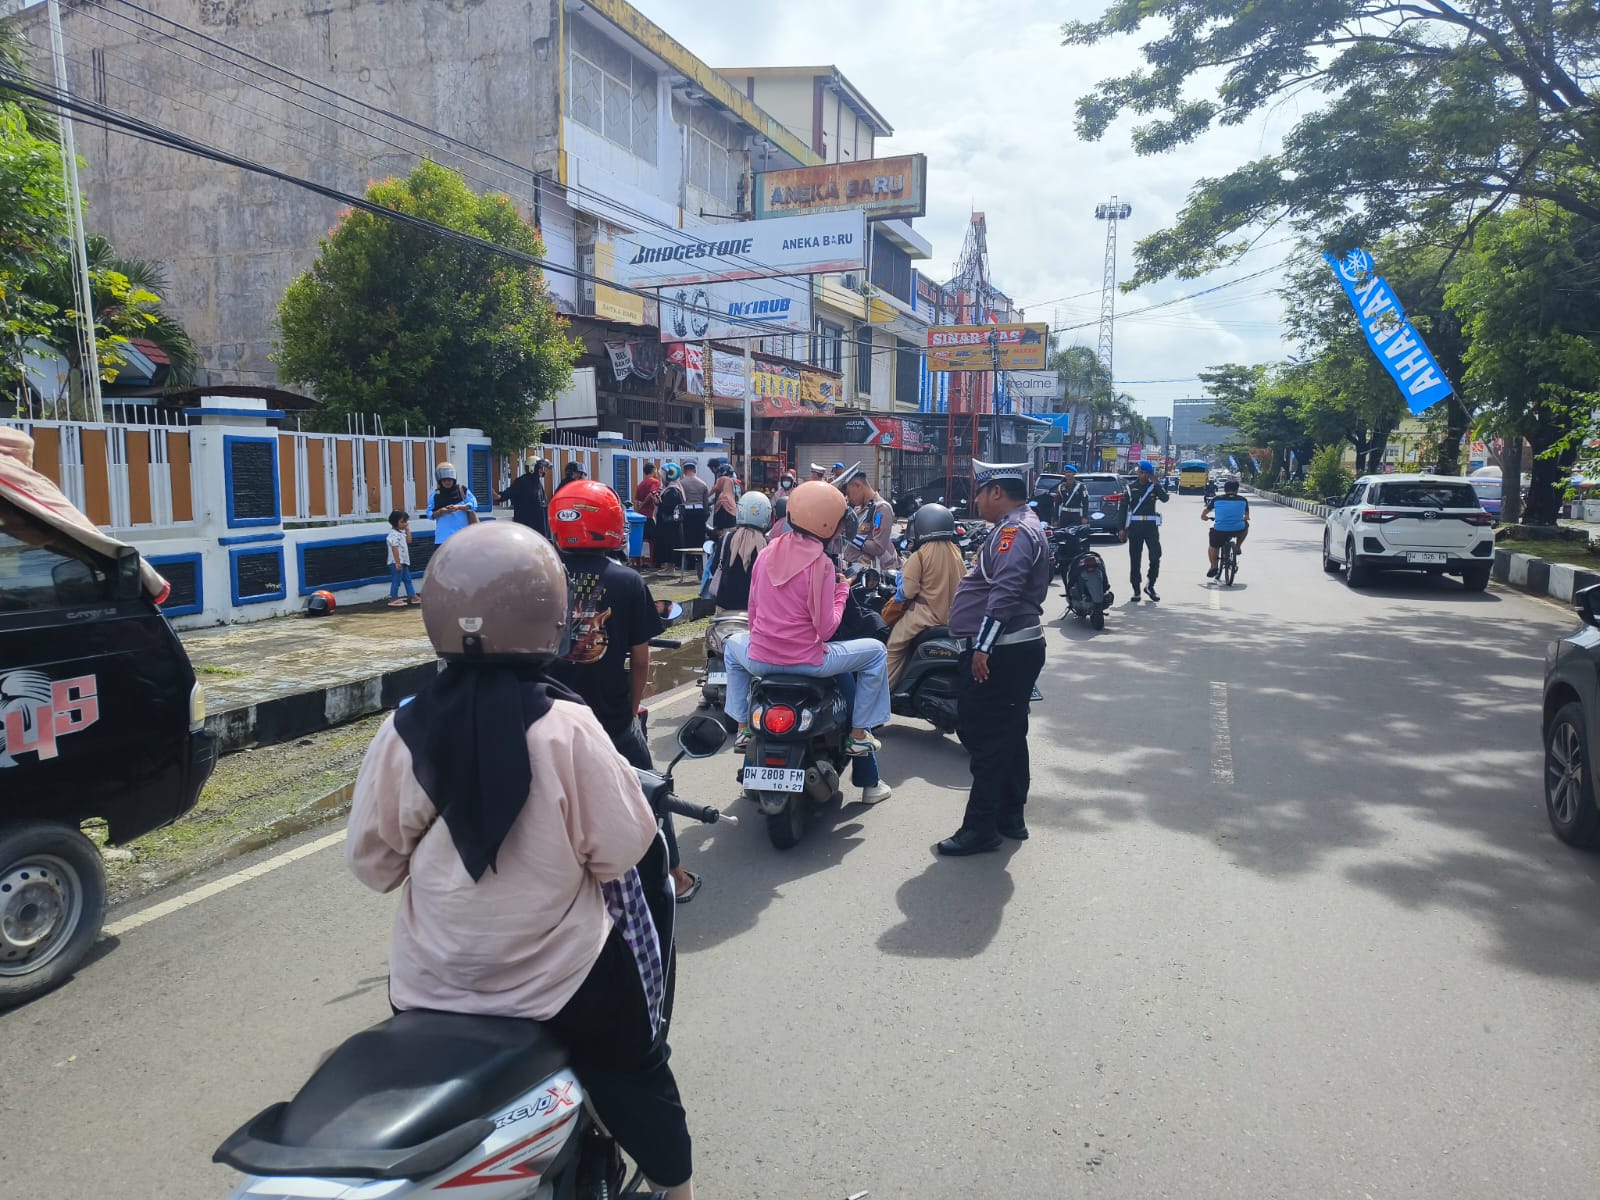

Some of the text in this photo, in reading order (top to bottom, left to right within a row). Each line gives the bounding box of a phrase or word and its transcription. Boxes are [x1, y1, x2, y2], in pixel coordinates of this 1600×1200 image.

[771, 175, 904, 205] ANEKA BARU
[782, 235, 820, 250] ANEKA
[629, 238, 753, 265] BRIDGESTONE
[728, 297, 791, 317] INTIRUB
[932, 331, 981, 345] SINAR
[1014, 378, 1052, 390] realme
[744, 768, 803, 781] DW 2808 FM
